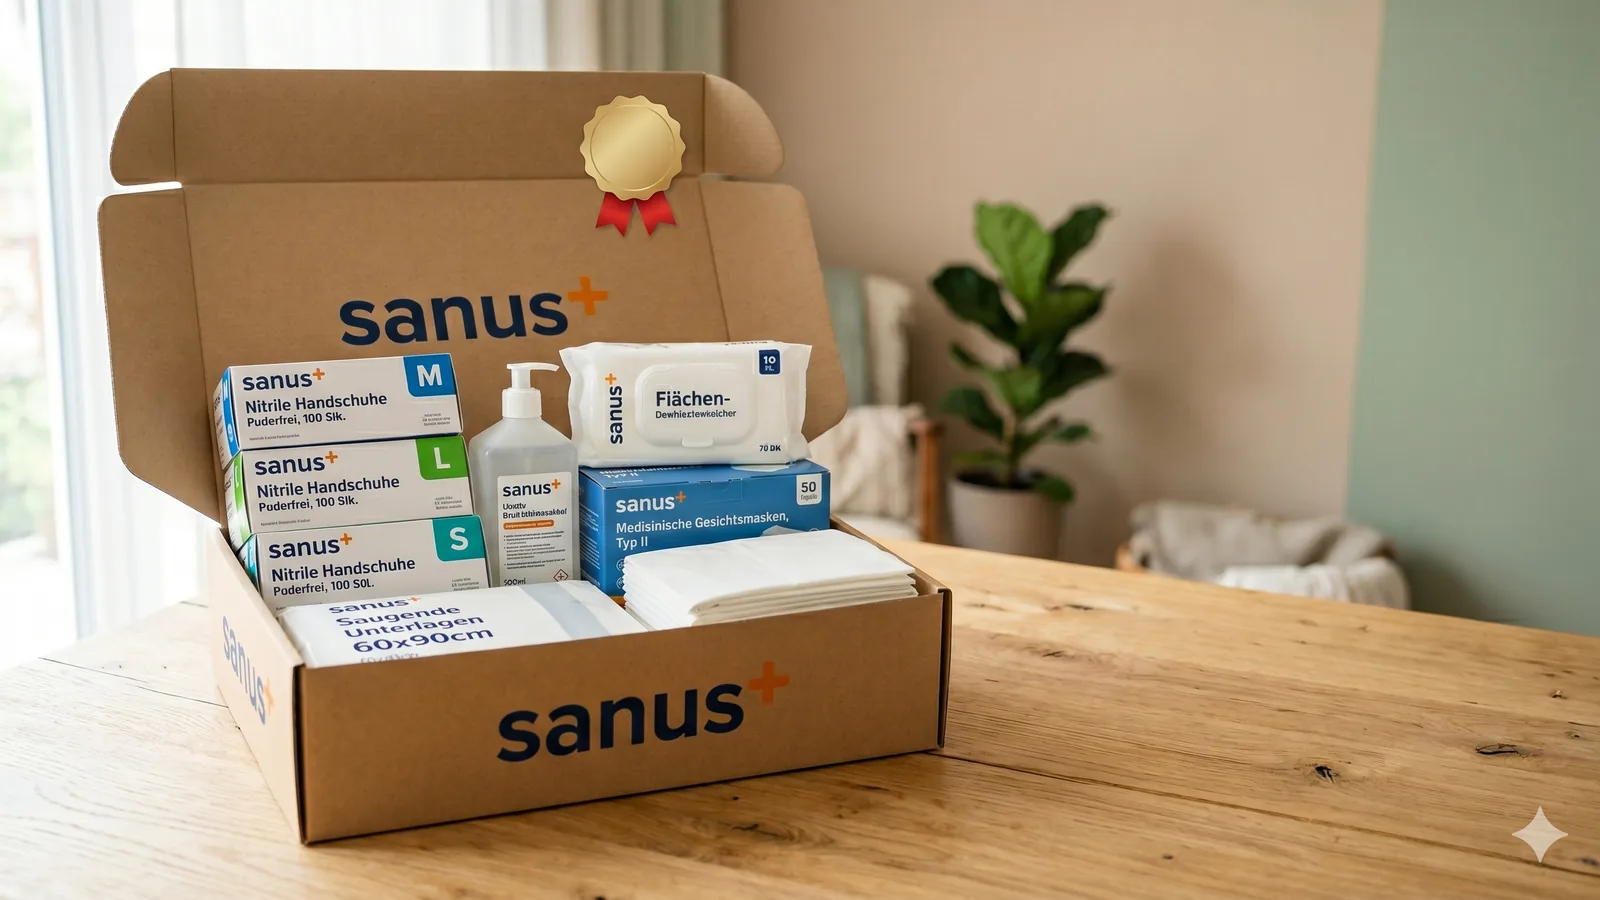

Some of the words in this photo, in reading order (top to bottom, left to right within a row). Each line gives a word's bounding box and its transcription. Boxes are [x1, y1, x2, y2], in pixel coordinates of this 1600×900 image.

[763, 355, 776, 364] 10
[416, 364, 443, 387] M
[245, 398, 292, 414] Nitrile
[295, 392, 388, 411] Handschuhe
[247, 414, 301, 428] Puderfrei,
[302, 413, 323, 423] 100
[433, 446, 451, 470] L
[759, 444, 769, 452] 70
[257, 482, 304, 499] Nitrile
[307, 475, 400, 495] Handschuhe
[801, 481, 817, 493] 50
[315, 497, 335, 507] 100
[616, 518, 692, 534] Medisinische
[695, 511, 789, 528] Gesichtsmasken,
[449, 527, 469, 551] S
[616, 537, 638, 550] Typ
[271, 565, 319, 582] Nitrile
[322, 557, 416, 578] Handschuhe
[331, 580, 350, 591] 100
[336, 606, 461, 626] Saugende
[344, 615, 484, 638] Unterlagen
[353, 628, 494, 653] 60x90cm
